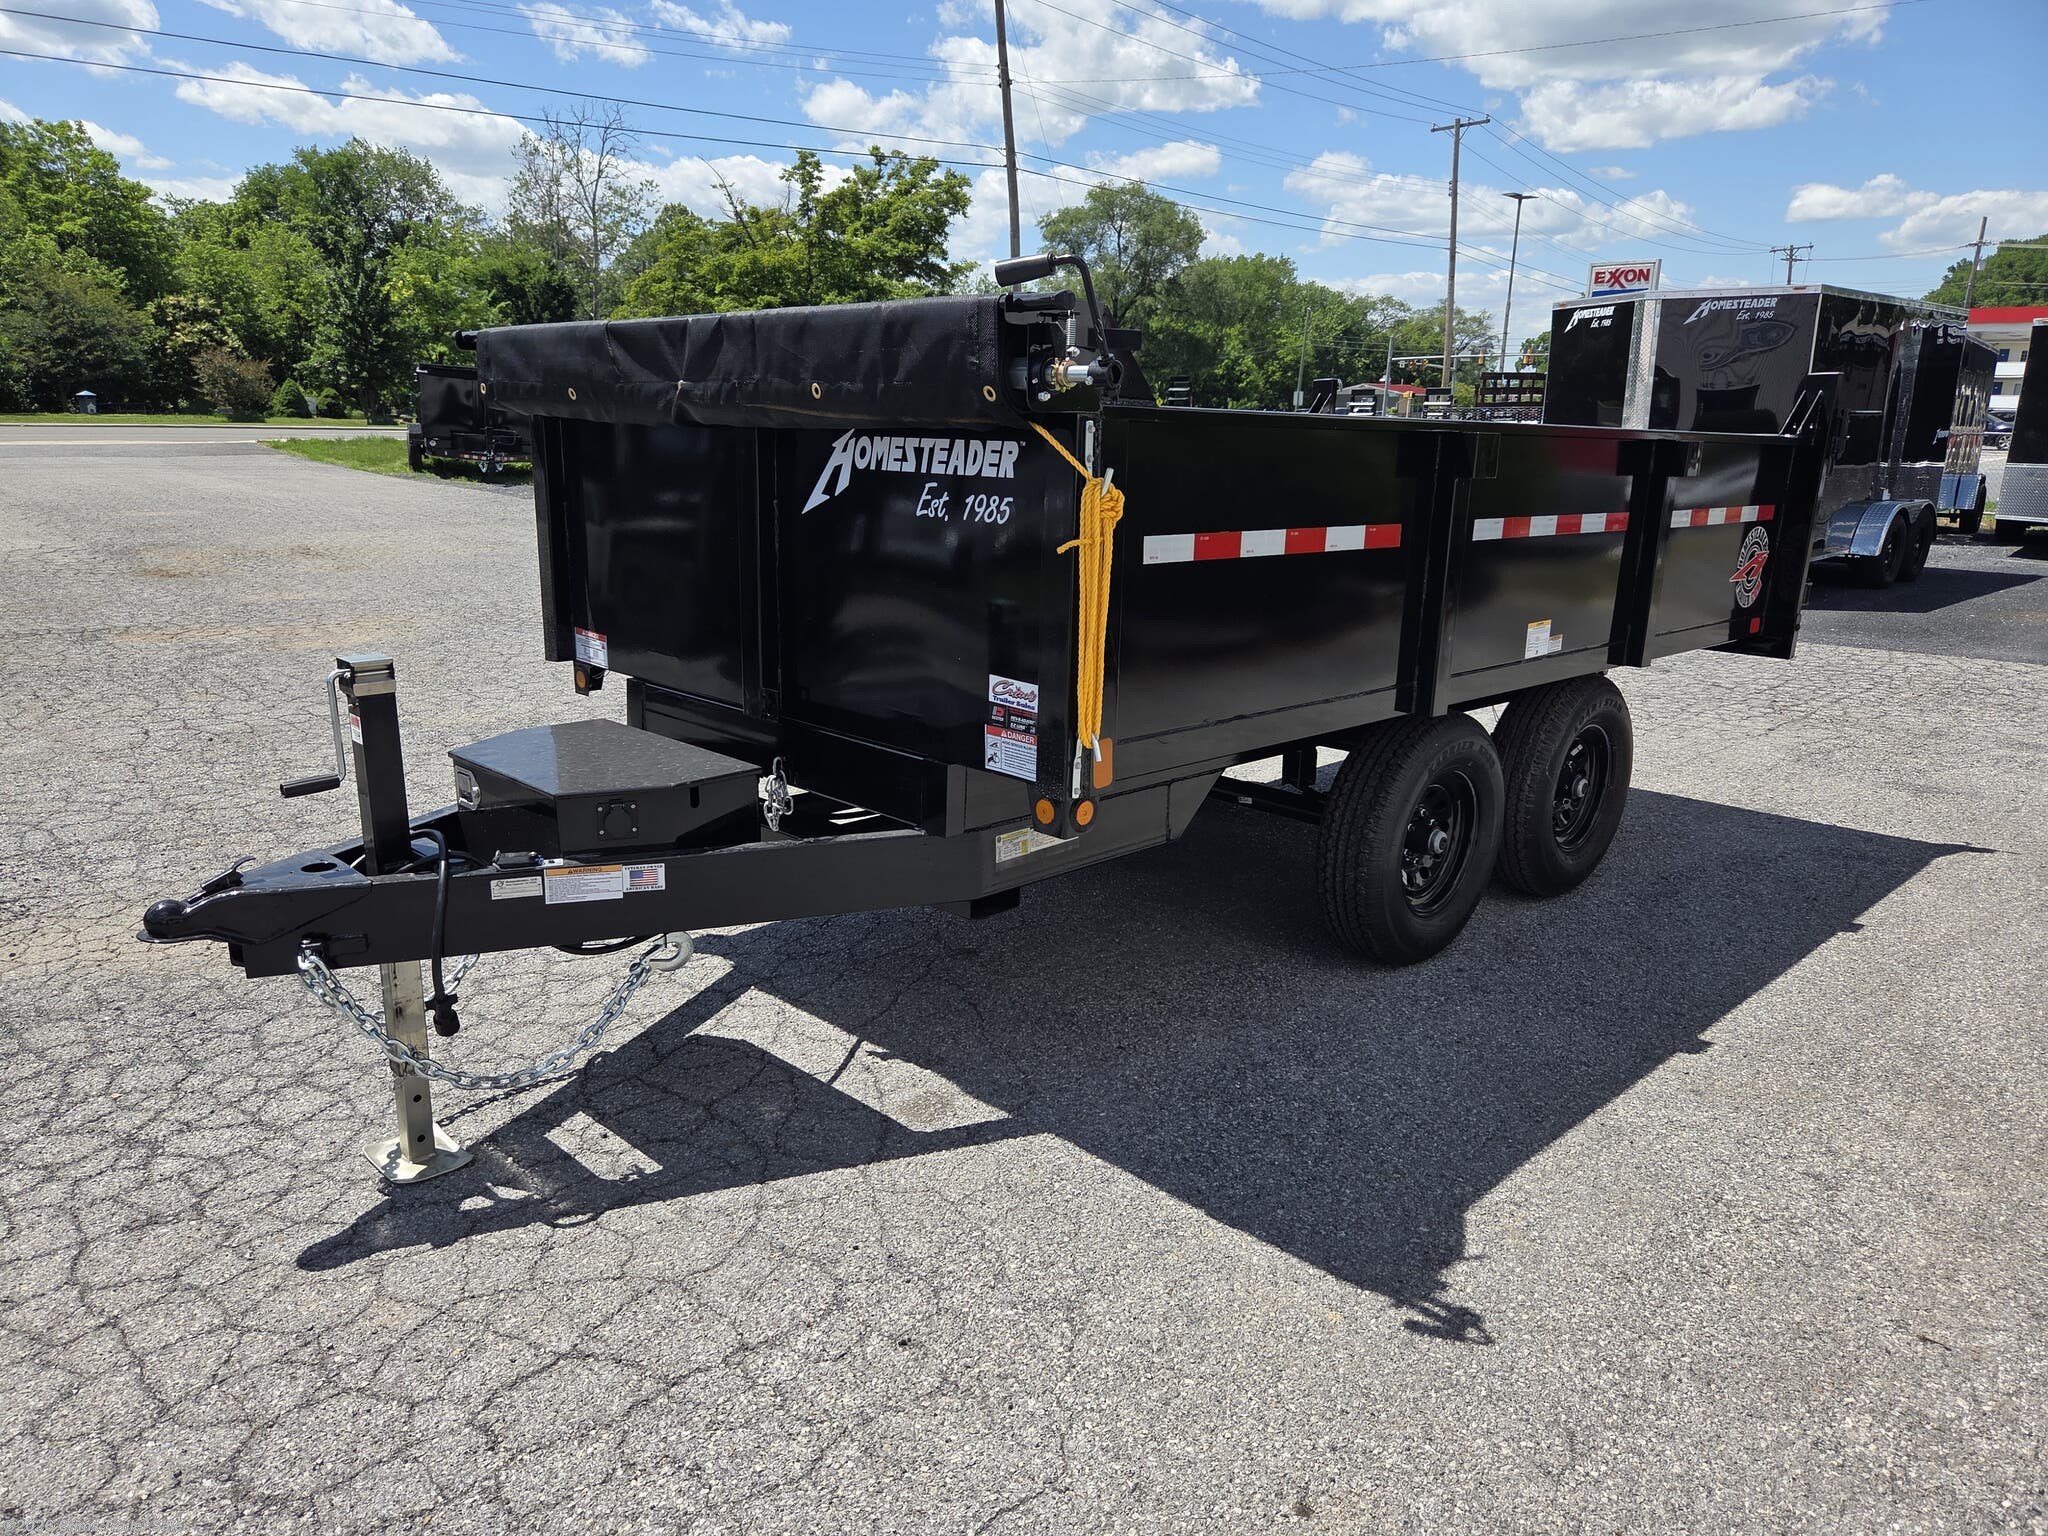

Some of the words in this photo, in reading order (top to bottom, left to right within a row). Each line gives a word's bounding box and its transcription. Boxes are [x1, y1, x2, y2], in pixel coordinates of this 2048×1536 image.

[1594, 267, 1651, 289] EXXON
[1563, 305, 1615, 334] HOMESTEADER
[1683, 297, 1778, 326] HOMESTEADER
[1735, 310, 1750, 321] Est.
[1755, 310, 1774, 320] 1985
[1601, 317, 1612, 328] 1985
[801, 428, 1020, 515] HOMESTEADER
[915, 481, 950, 522] Est.
[963, 493, 1014, 525] 1985
[992, 694, 1015, 706] Trailer
[1016, 699, 1036, 711] Sales
[1007, 730, 1035, 744] DANGER
[573, 866, 602, 874] WARNING
